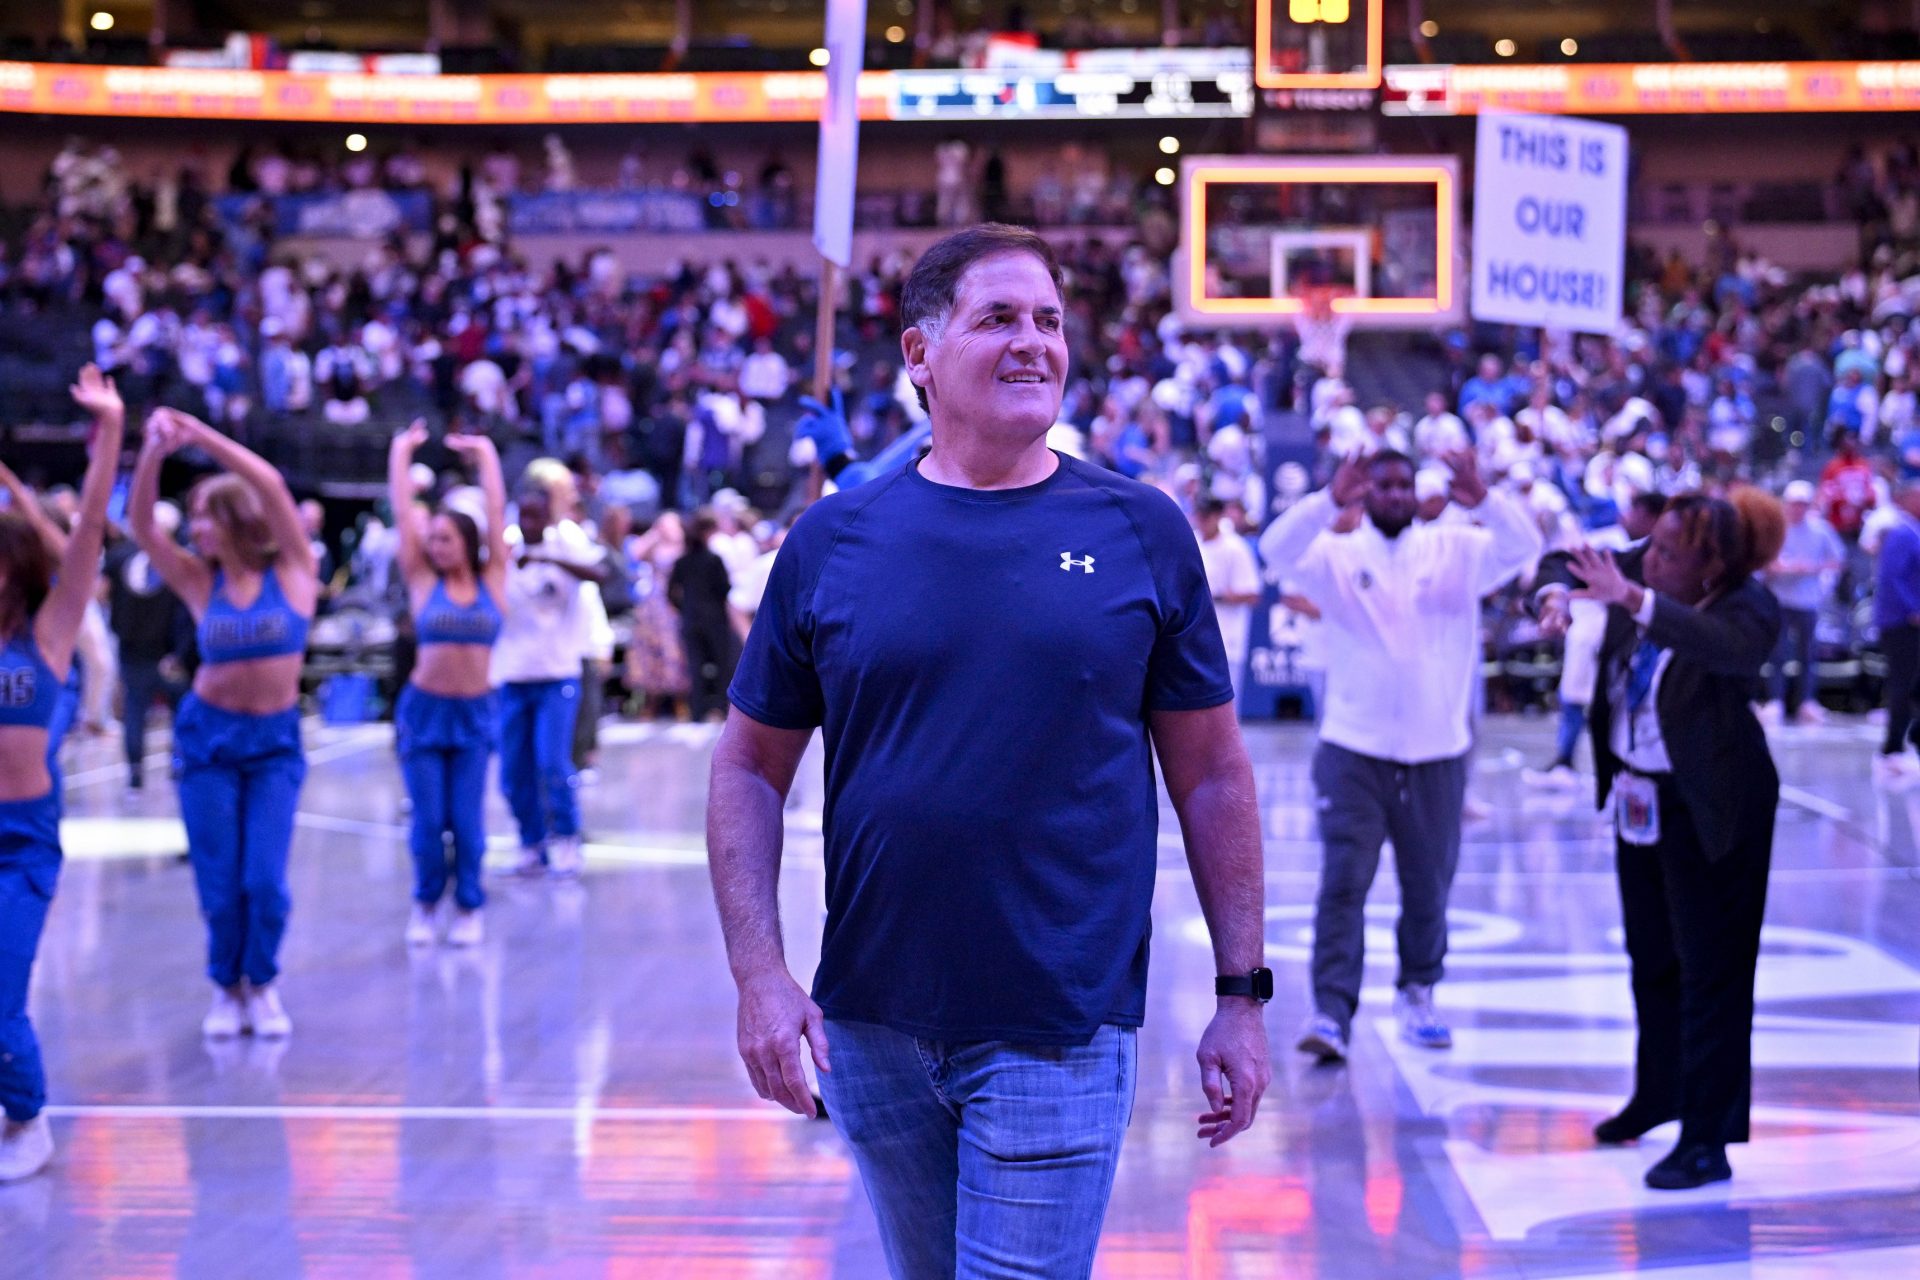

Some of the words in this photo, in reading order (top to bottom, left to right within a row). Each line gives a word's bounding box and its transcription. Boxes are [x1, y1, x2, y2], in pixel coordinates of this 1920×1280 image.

[1500, 125, 1567, 170] THIS
[1579, 139, 1606, 177] IS
[1515, 196, 1585, 238] OUR
[1488, 261, 1606, 309] HOUSE!
